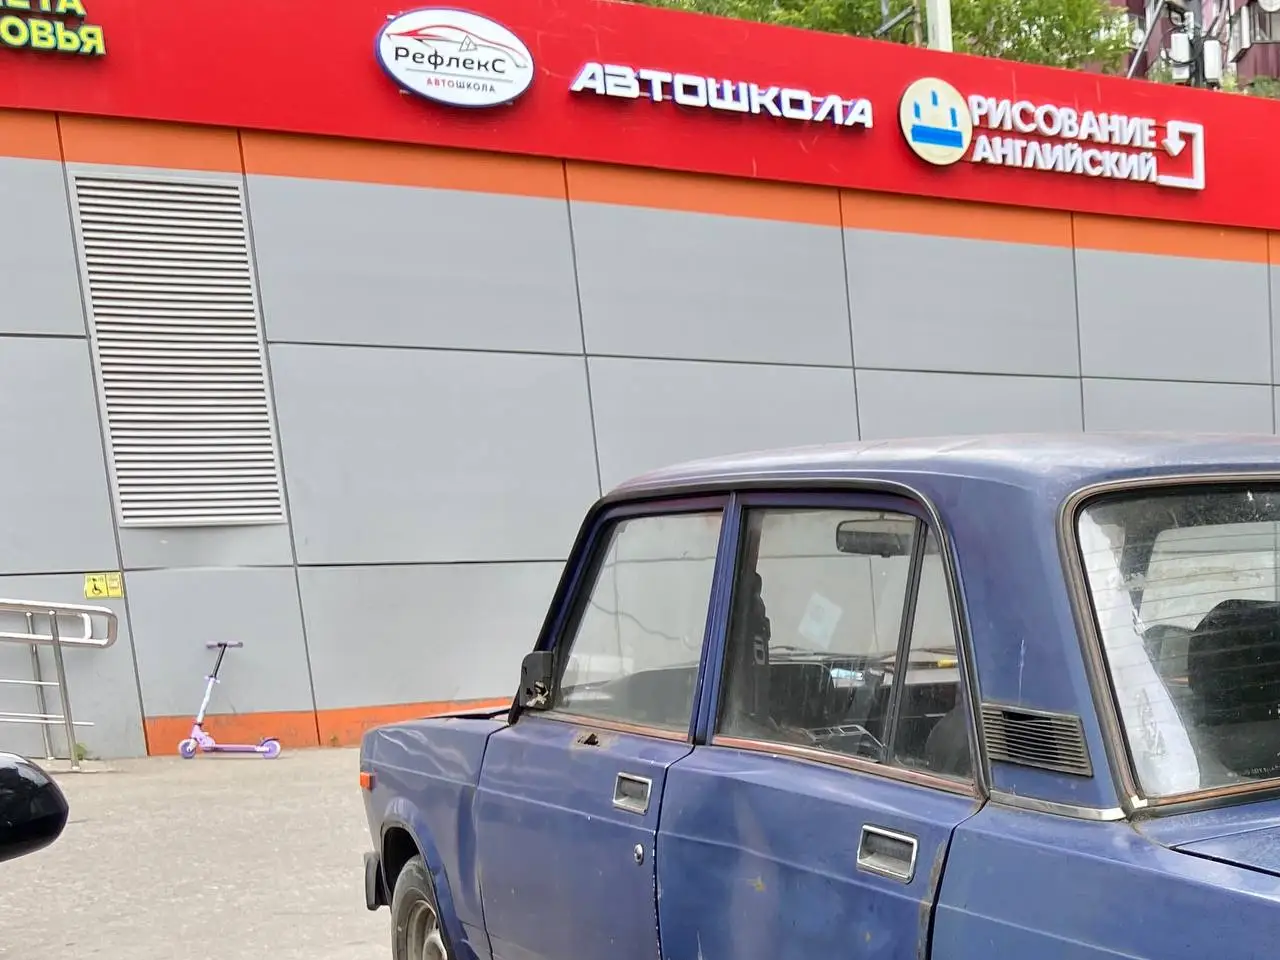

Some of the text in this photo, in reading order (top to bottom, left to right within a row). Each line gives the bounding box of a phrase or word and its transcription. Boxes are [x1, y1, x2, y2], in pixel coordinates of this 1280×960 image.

[0, 15, 106, 55] ОВЬЯ
[426, 78, 496, 93] АВТОШКОЛА
[570, 62, 874, 129] АВТОШКОЛА
[968, 95, 1157, 149] РИСОВАНИЕ
[972, 134, 1158, 183] АНГЛИЙСКИЙ
